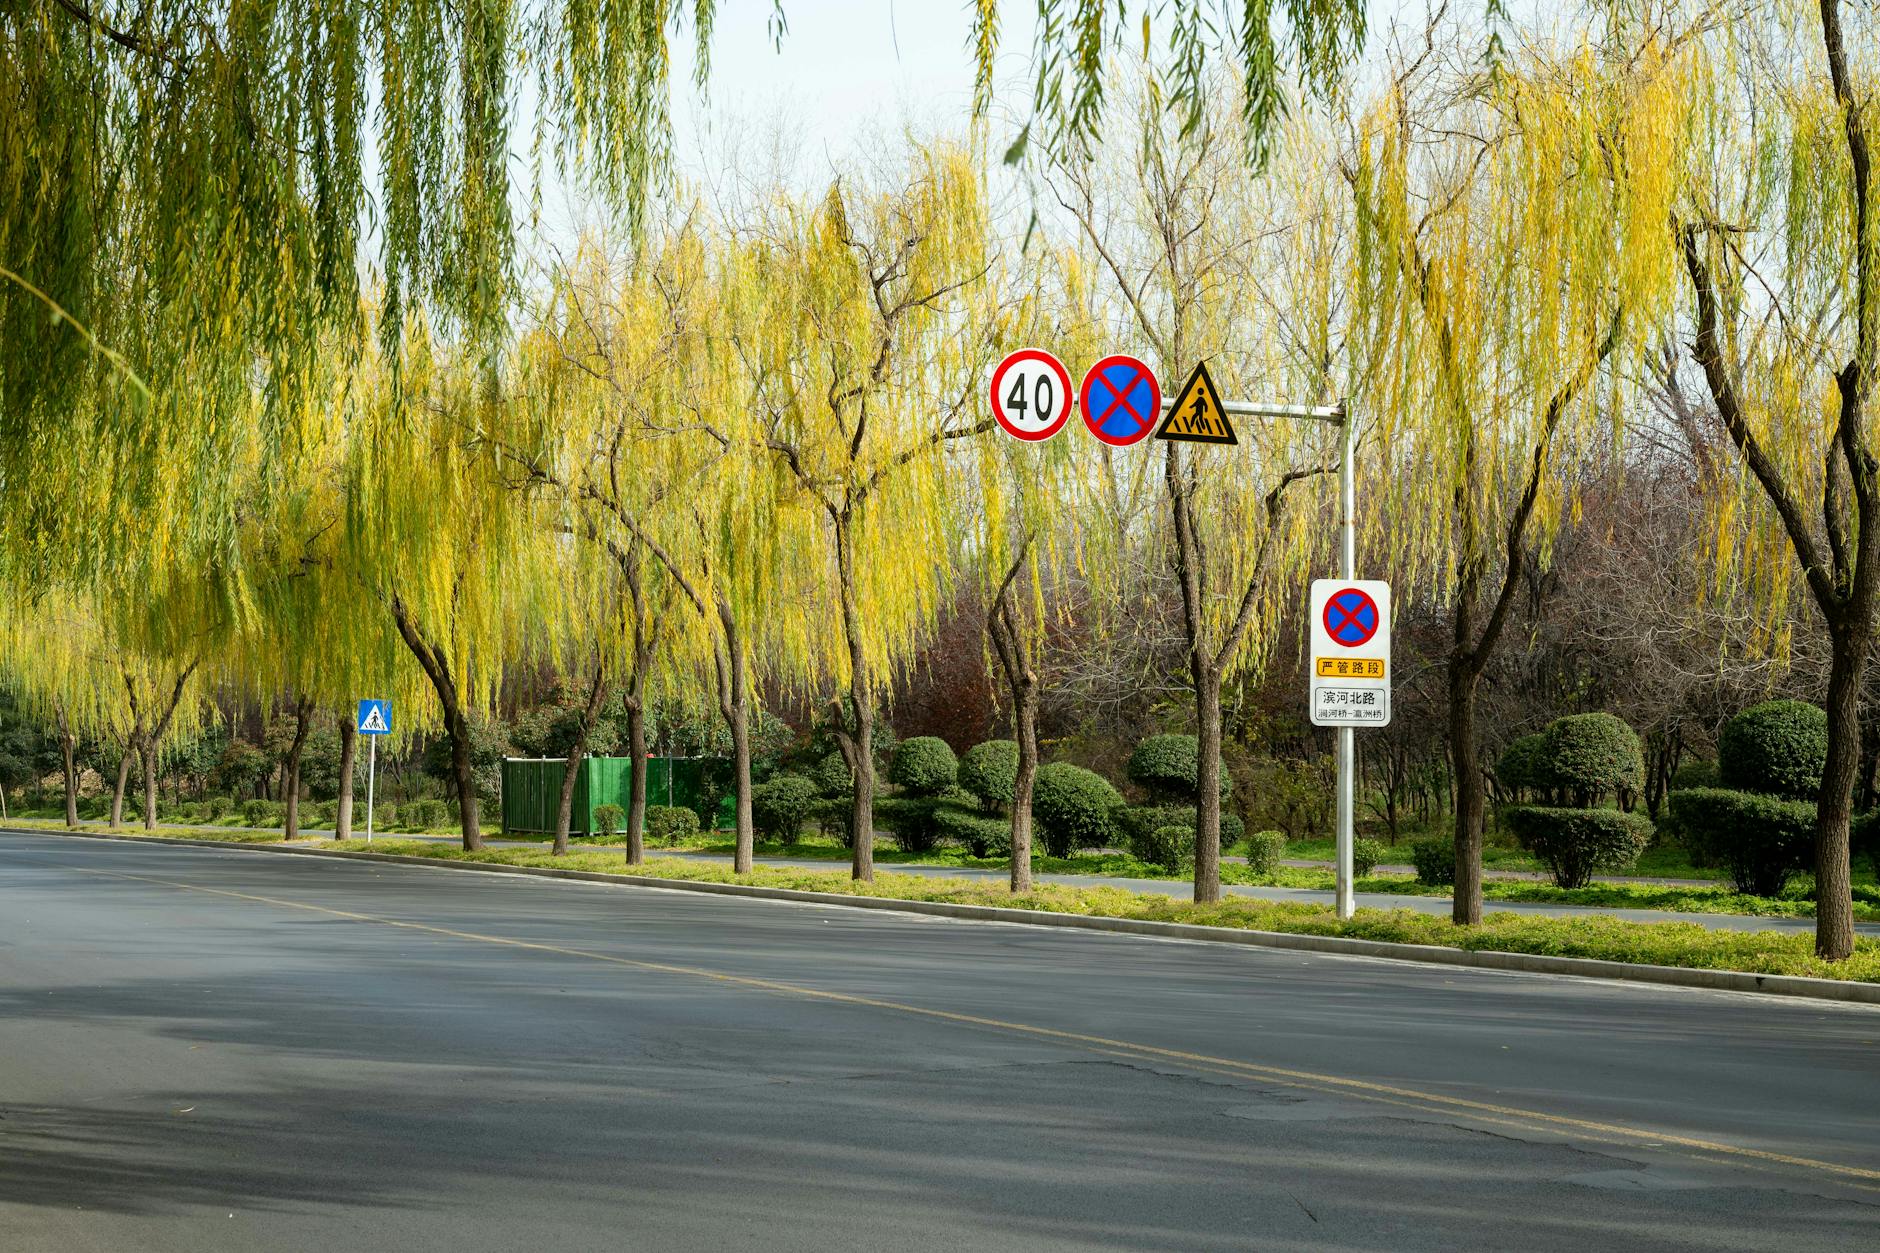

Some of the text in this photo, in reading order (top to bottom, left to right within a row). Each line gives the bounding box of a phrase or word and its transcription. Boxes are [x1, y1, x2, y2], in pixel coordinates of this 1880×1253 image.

[1007, 373, 1053, 421] 40
[1322, 661, 1379, 674] 严管路段
[1323, 691, 1375, 705] 滨河北路
